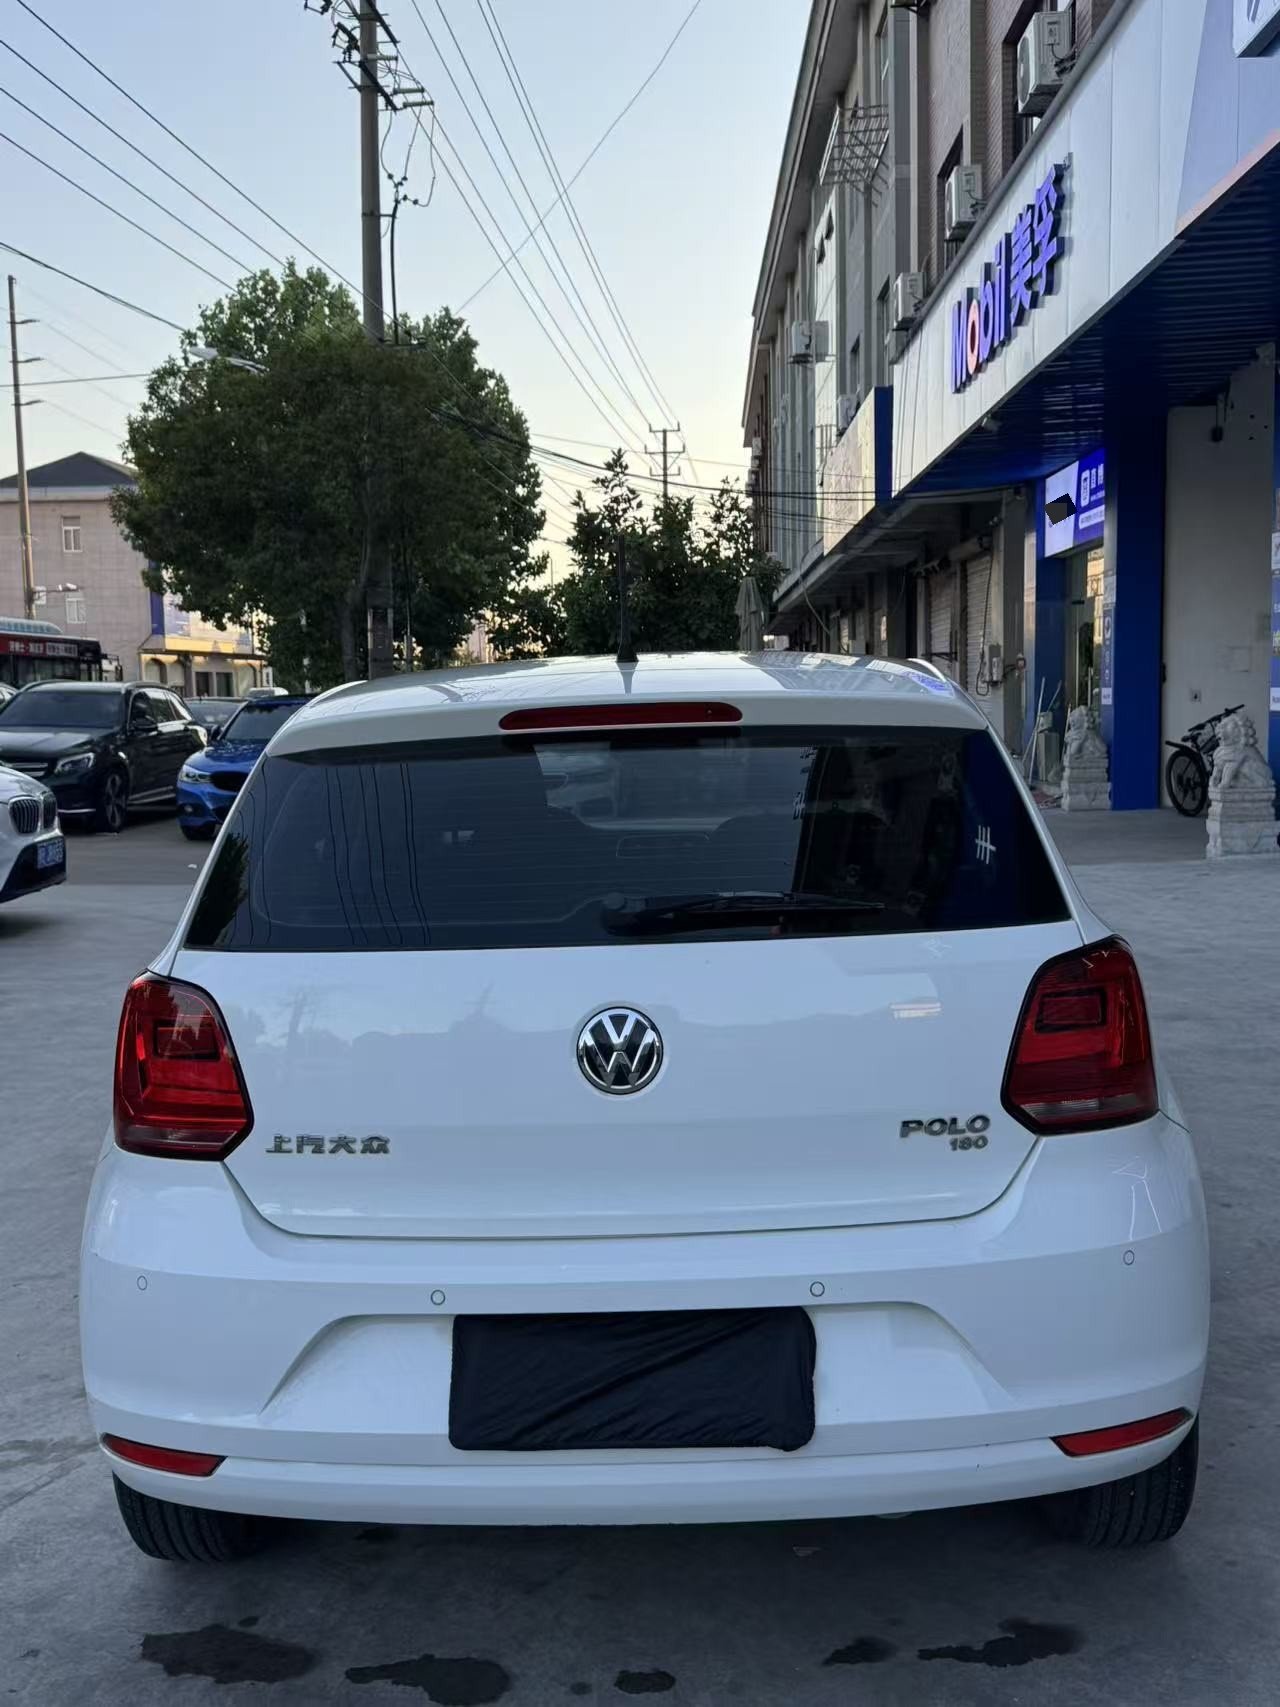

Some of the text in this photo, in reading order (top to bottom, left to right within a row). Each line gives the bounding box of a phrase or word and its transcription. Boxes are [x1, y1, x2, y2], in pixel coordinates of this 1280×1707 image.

[900, 1115, 990, 1138] POLO
[265, 1134, 390, 1154] 上汽大众
[950, 1135, 989, 1151] 180
